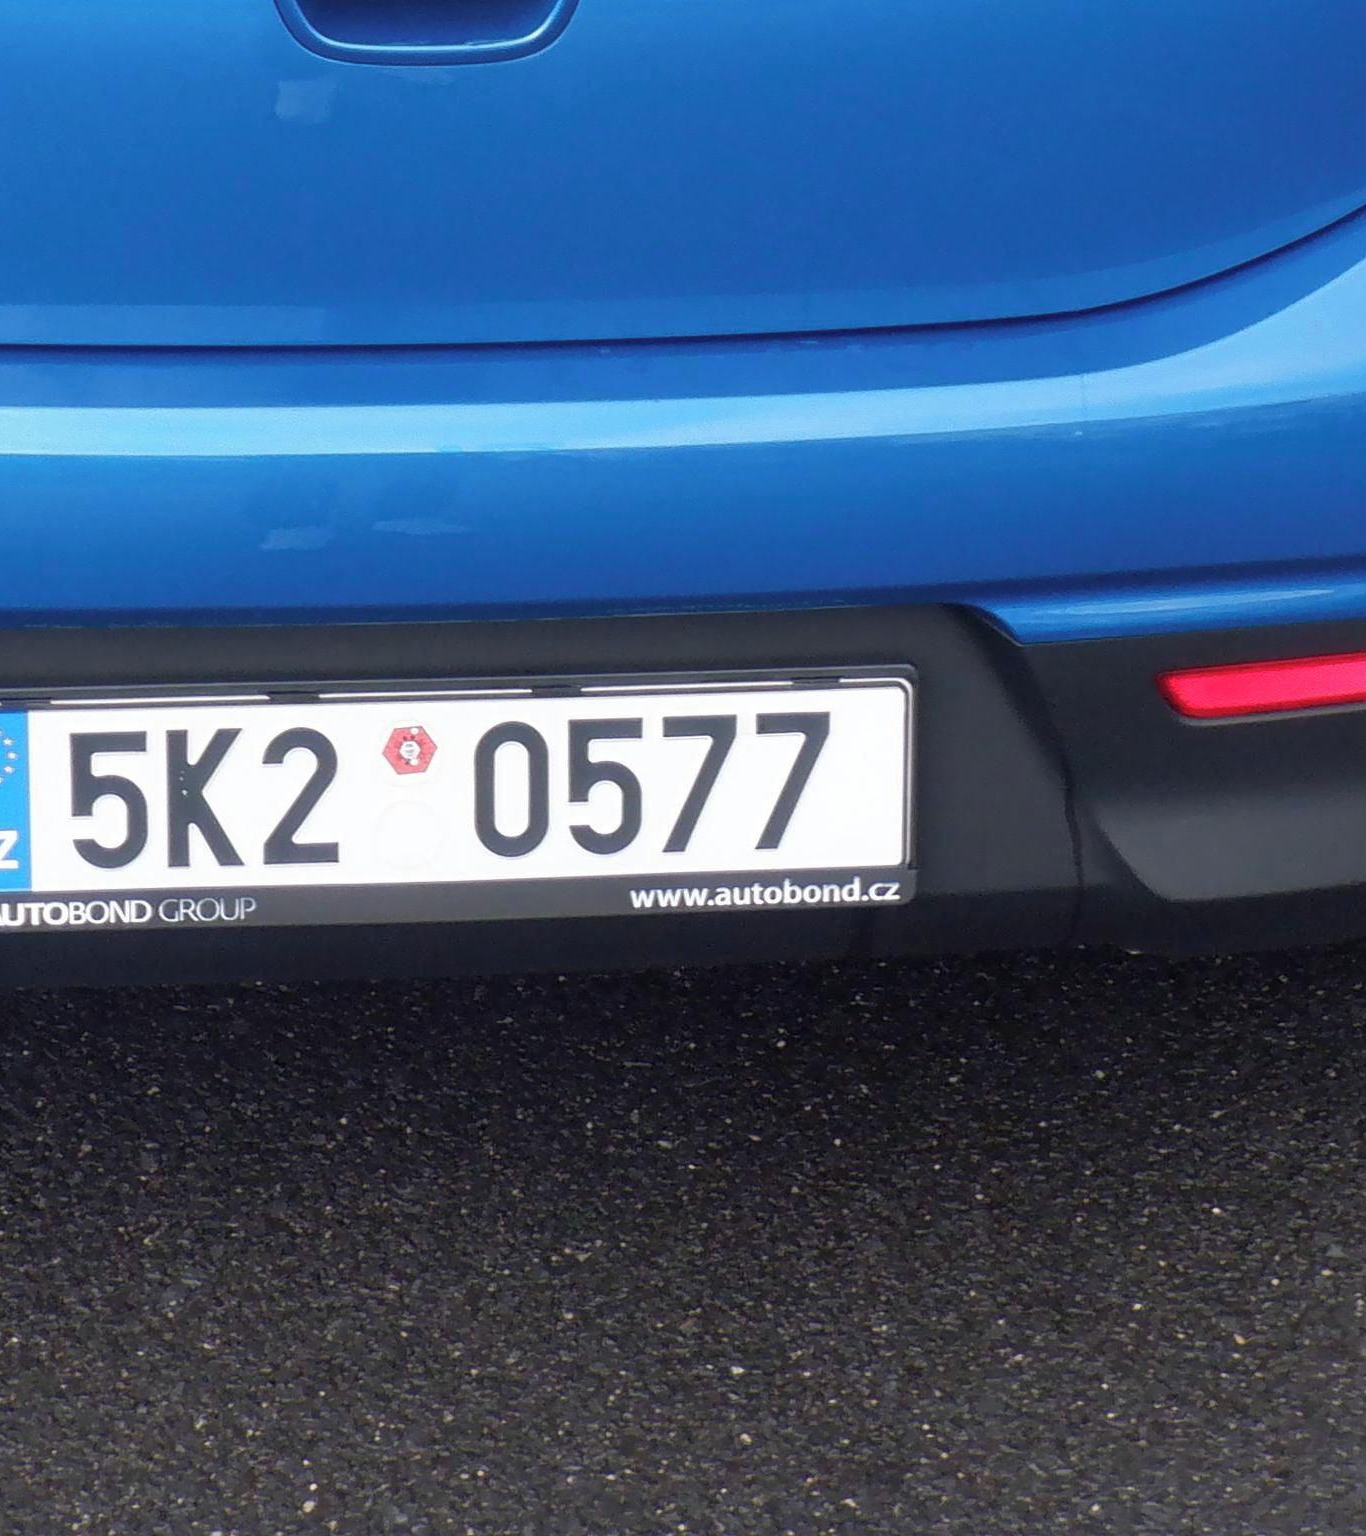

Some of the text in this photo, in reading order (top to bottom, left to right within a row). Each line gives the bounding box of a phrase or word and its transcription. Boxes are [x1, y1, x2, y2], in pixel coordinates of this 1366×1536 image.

[69, 712, 830, 868] 5K2 0577
[630, 876, 901, 908] www.autobond.cz
[158, 897, 256, 922] GROUP
